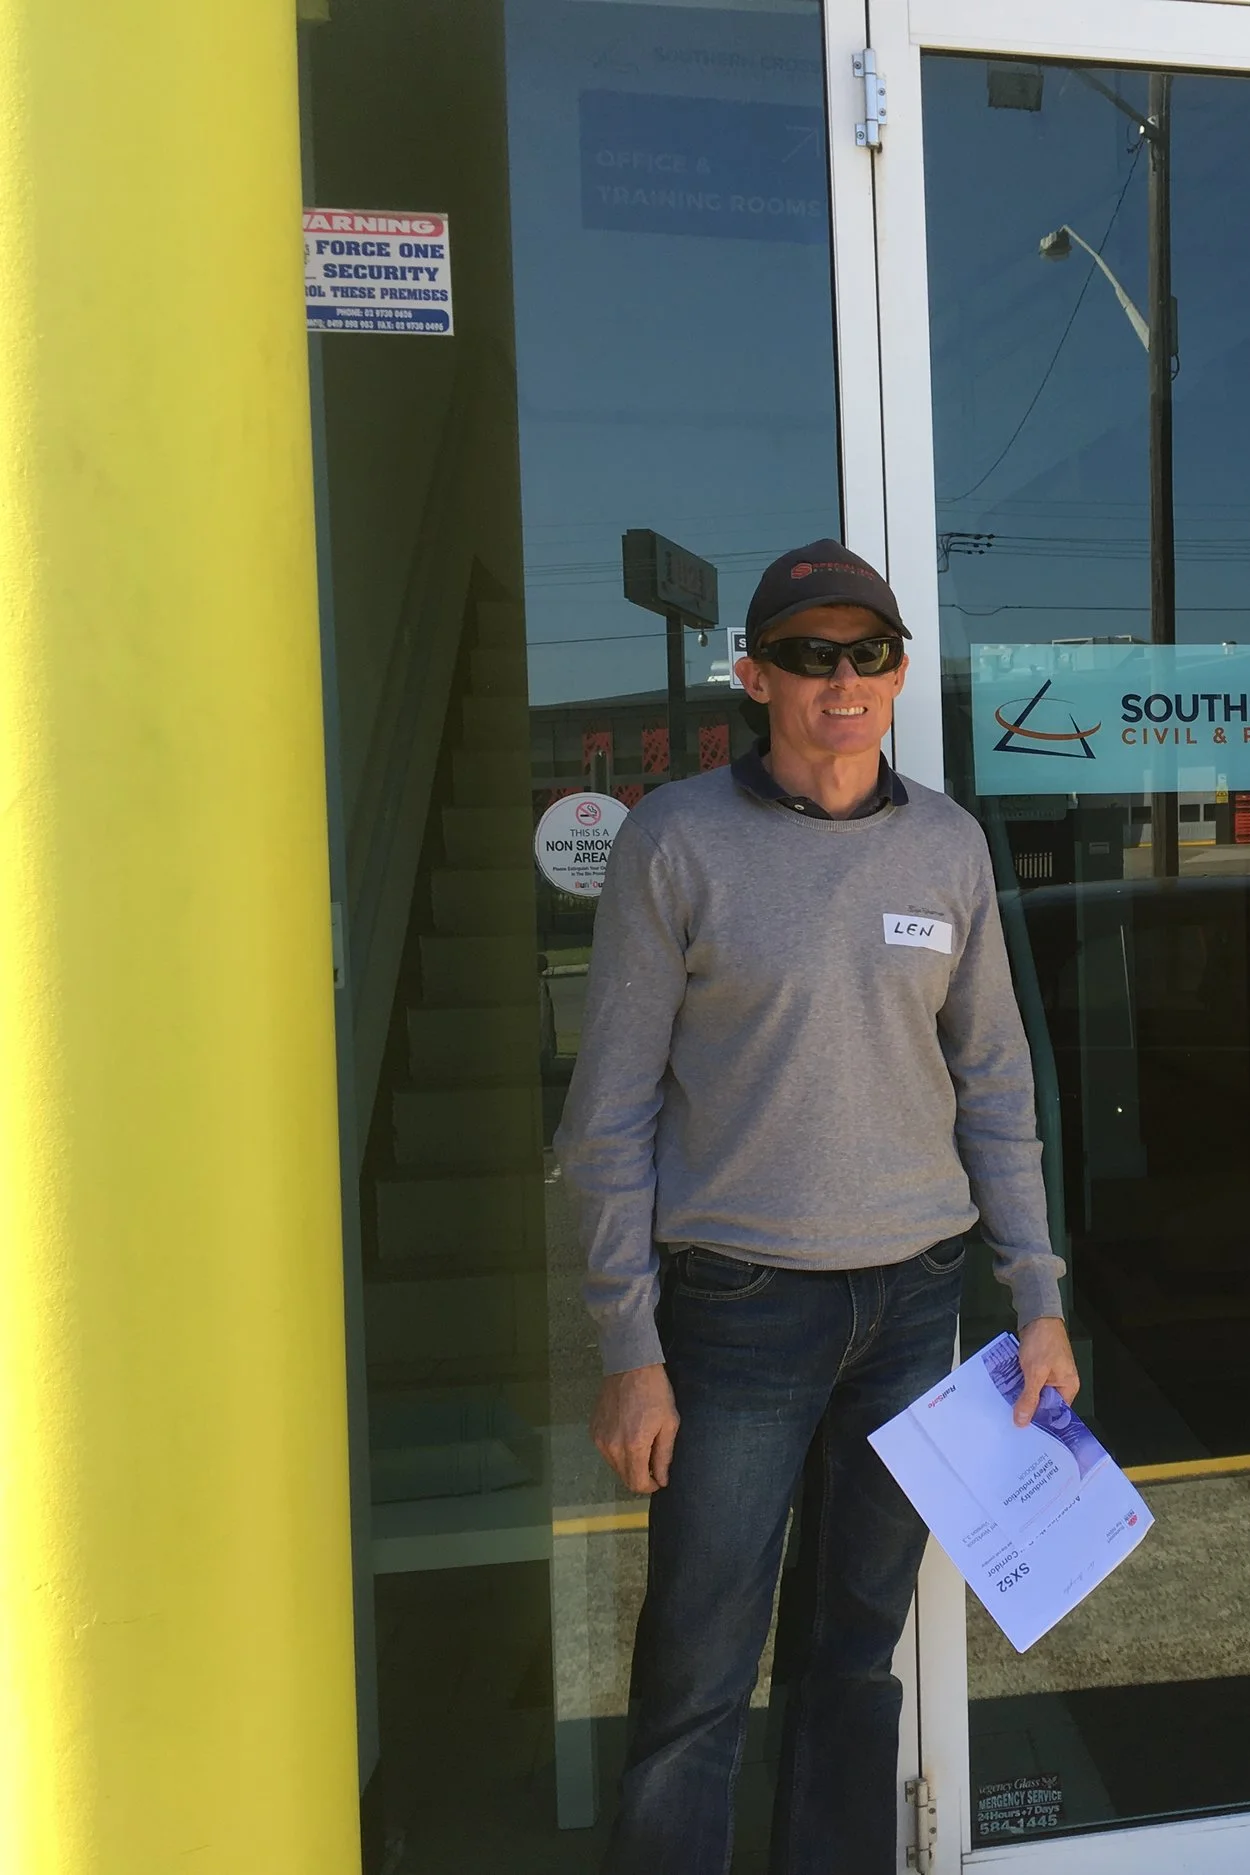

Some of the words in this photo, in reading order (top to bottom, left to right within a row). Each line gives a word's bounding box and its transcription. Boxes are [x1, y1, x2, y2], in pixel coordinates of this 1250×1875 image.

[596, 148, 688, 174] OFFICE
[597, 185, 723, 212] TRAINING
[730, 195, 822, 218] ROOMS
[303, 214, 435, 234] ARNING
[316, 239, 391, 258] FORCE
[399, 243, 444, 259] ONE
[323, 263, 439, 282] SECURITY
[330, 286, 376, 300] THESE
[380, 287, 449, 302] PREMISES
[377, 321, 394, 330] FAX:
[1121, 727, 1198, 745] CIVIL
[1213, 727, 1227, 743] &
[570, 828, 590, 837] THIS
[592, 829, 600, 837] IS
[602, 829, 609, 837] A
[546, 841, 573, 851] NON
[576, 840, 613, 851] SMOK
[574, 852, 607, 863] AREA
[894, 921, 935, 937] LEN
[1018, 1452, 1049, 1481] Handbook
[1033, 1459, 1055, 1481] Safety
[1046, 1465, 1060, 1479] Rail
[1003, 1476, 1035, 1507] Induction
[1019, 1476, 1048, 1504] Industry
[987, 1550, 1019, 1578] Corridor
[996, 1562, 1030, 1593] SX52
[1014, 1777, 1040, 1790] Glass
[978, 1791, 1026, 1810] MERGENCY
[1027, 1789, 1063, 1805] SERVICE
[989, 1810, 1021, 1820] Hours
[1026, 1806, 1034, 1816] 7
[1035, 1805, 1060, 1815] Days
[979, 1820, 1010, 1836] 584
[1017, 1814, 1059, 1829] 1445
